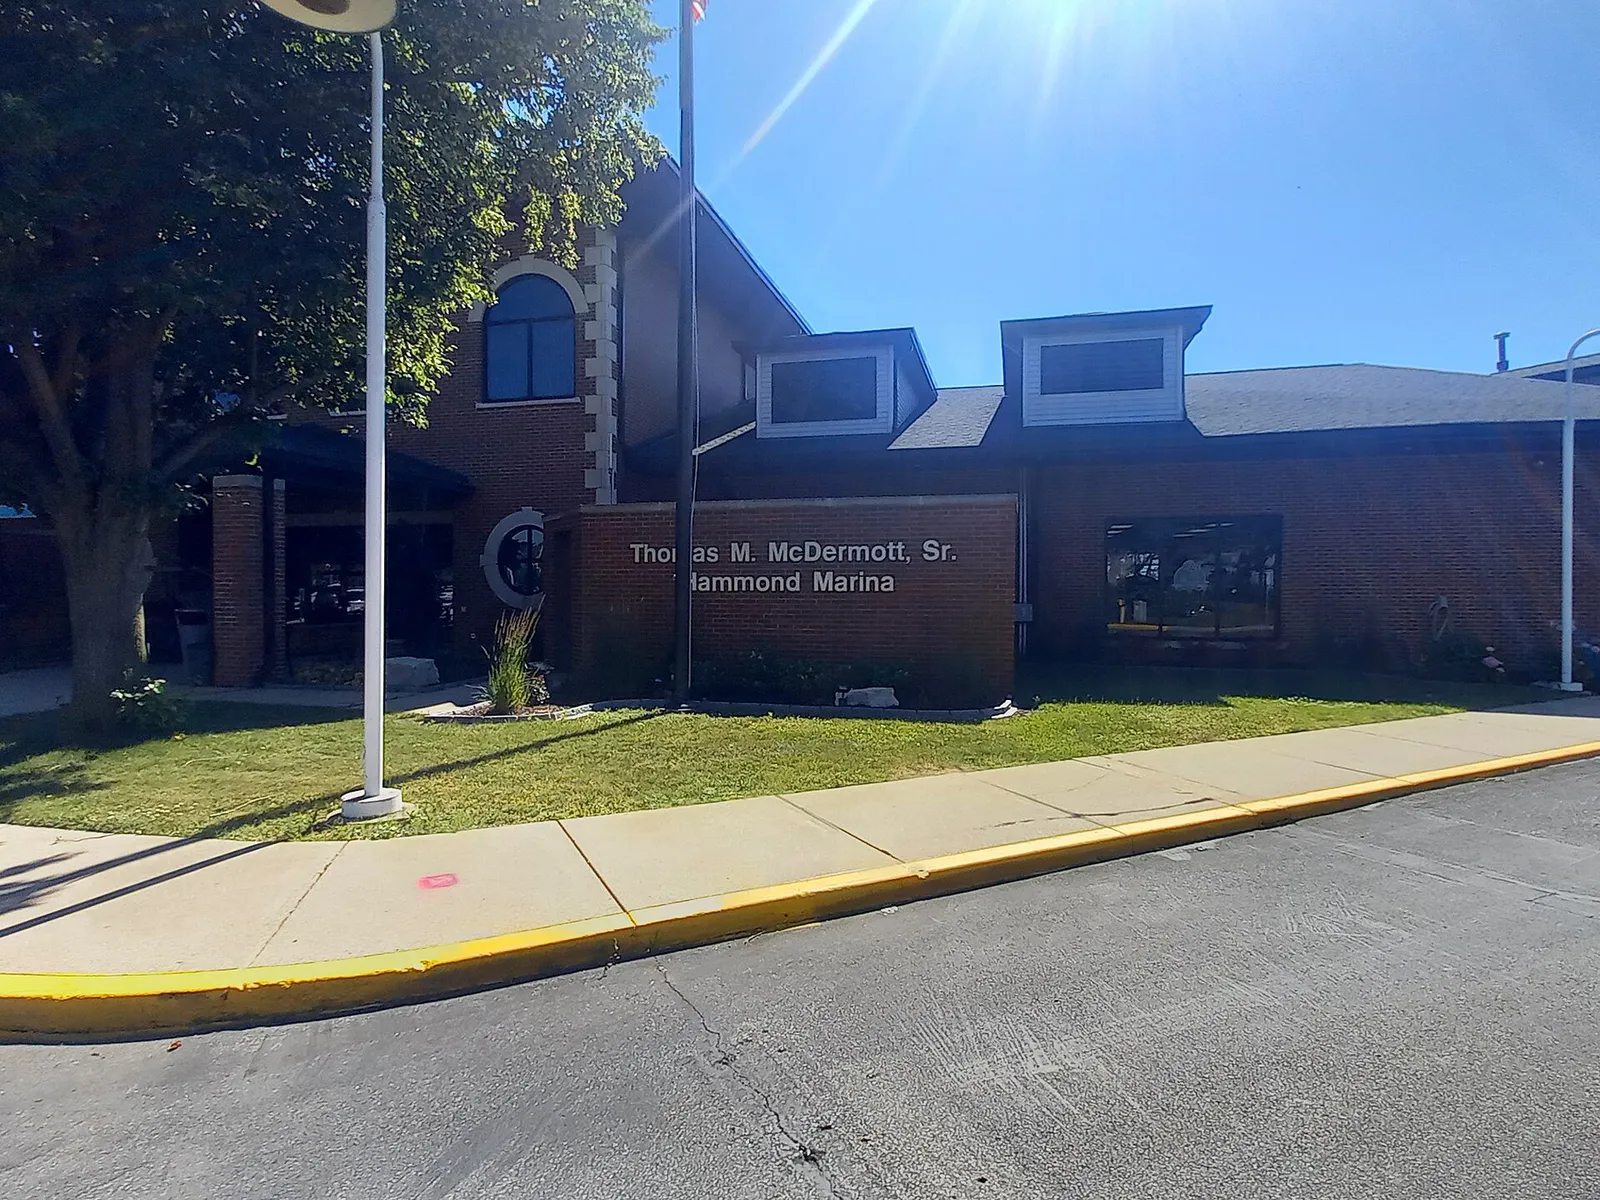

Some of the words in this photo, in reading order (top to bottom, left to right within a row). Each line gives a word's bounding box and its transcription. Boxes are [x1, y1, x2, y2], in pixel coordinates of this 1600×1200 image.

[629, 543, 719, 563] Thoas
[730, 542, 757, 562] M.
[768, 541, 911, 564] McDermott,
[922, 539, 957, 561] Sr.
[813, 571, 895, 592] Marina
